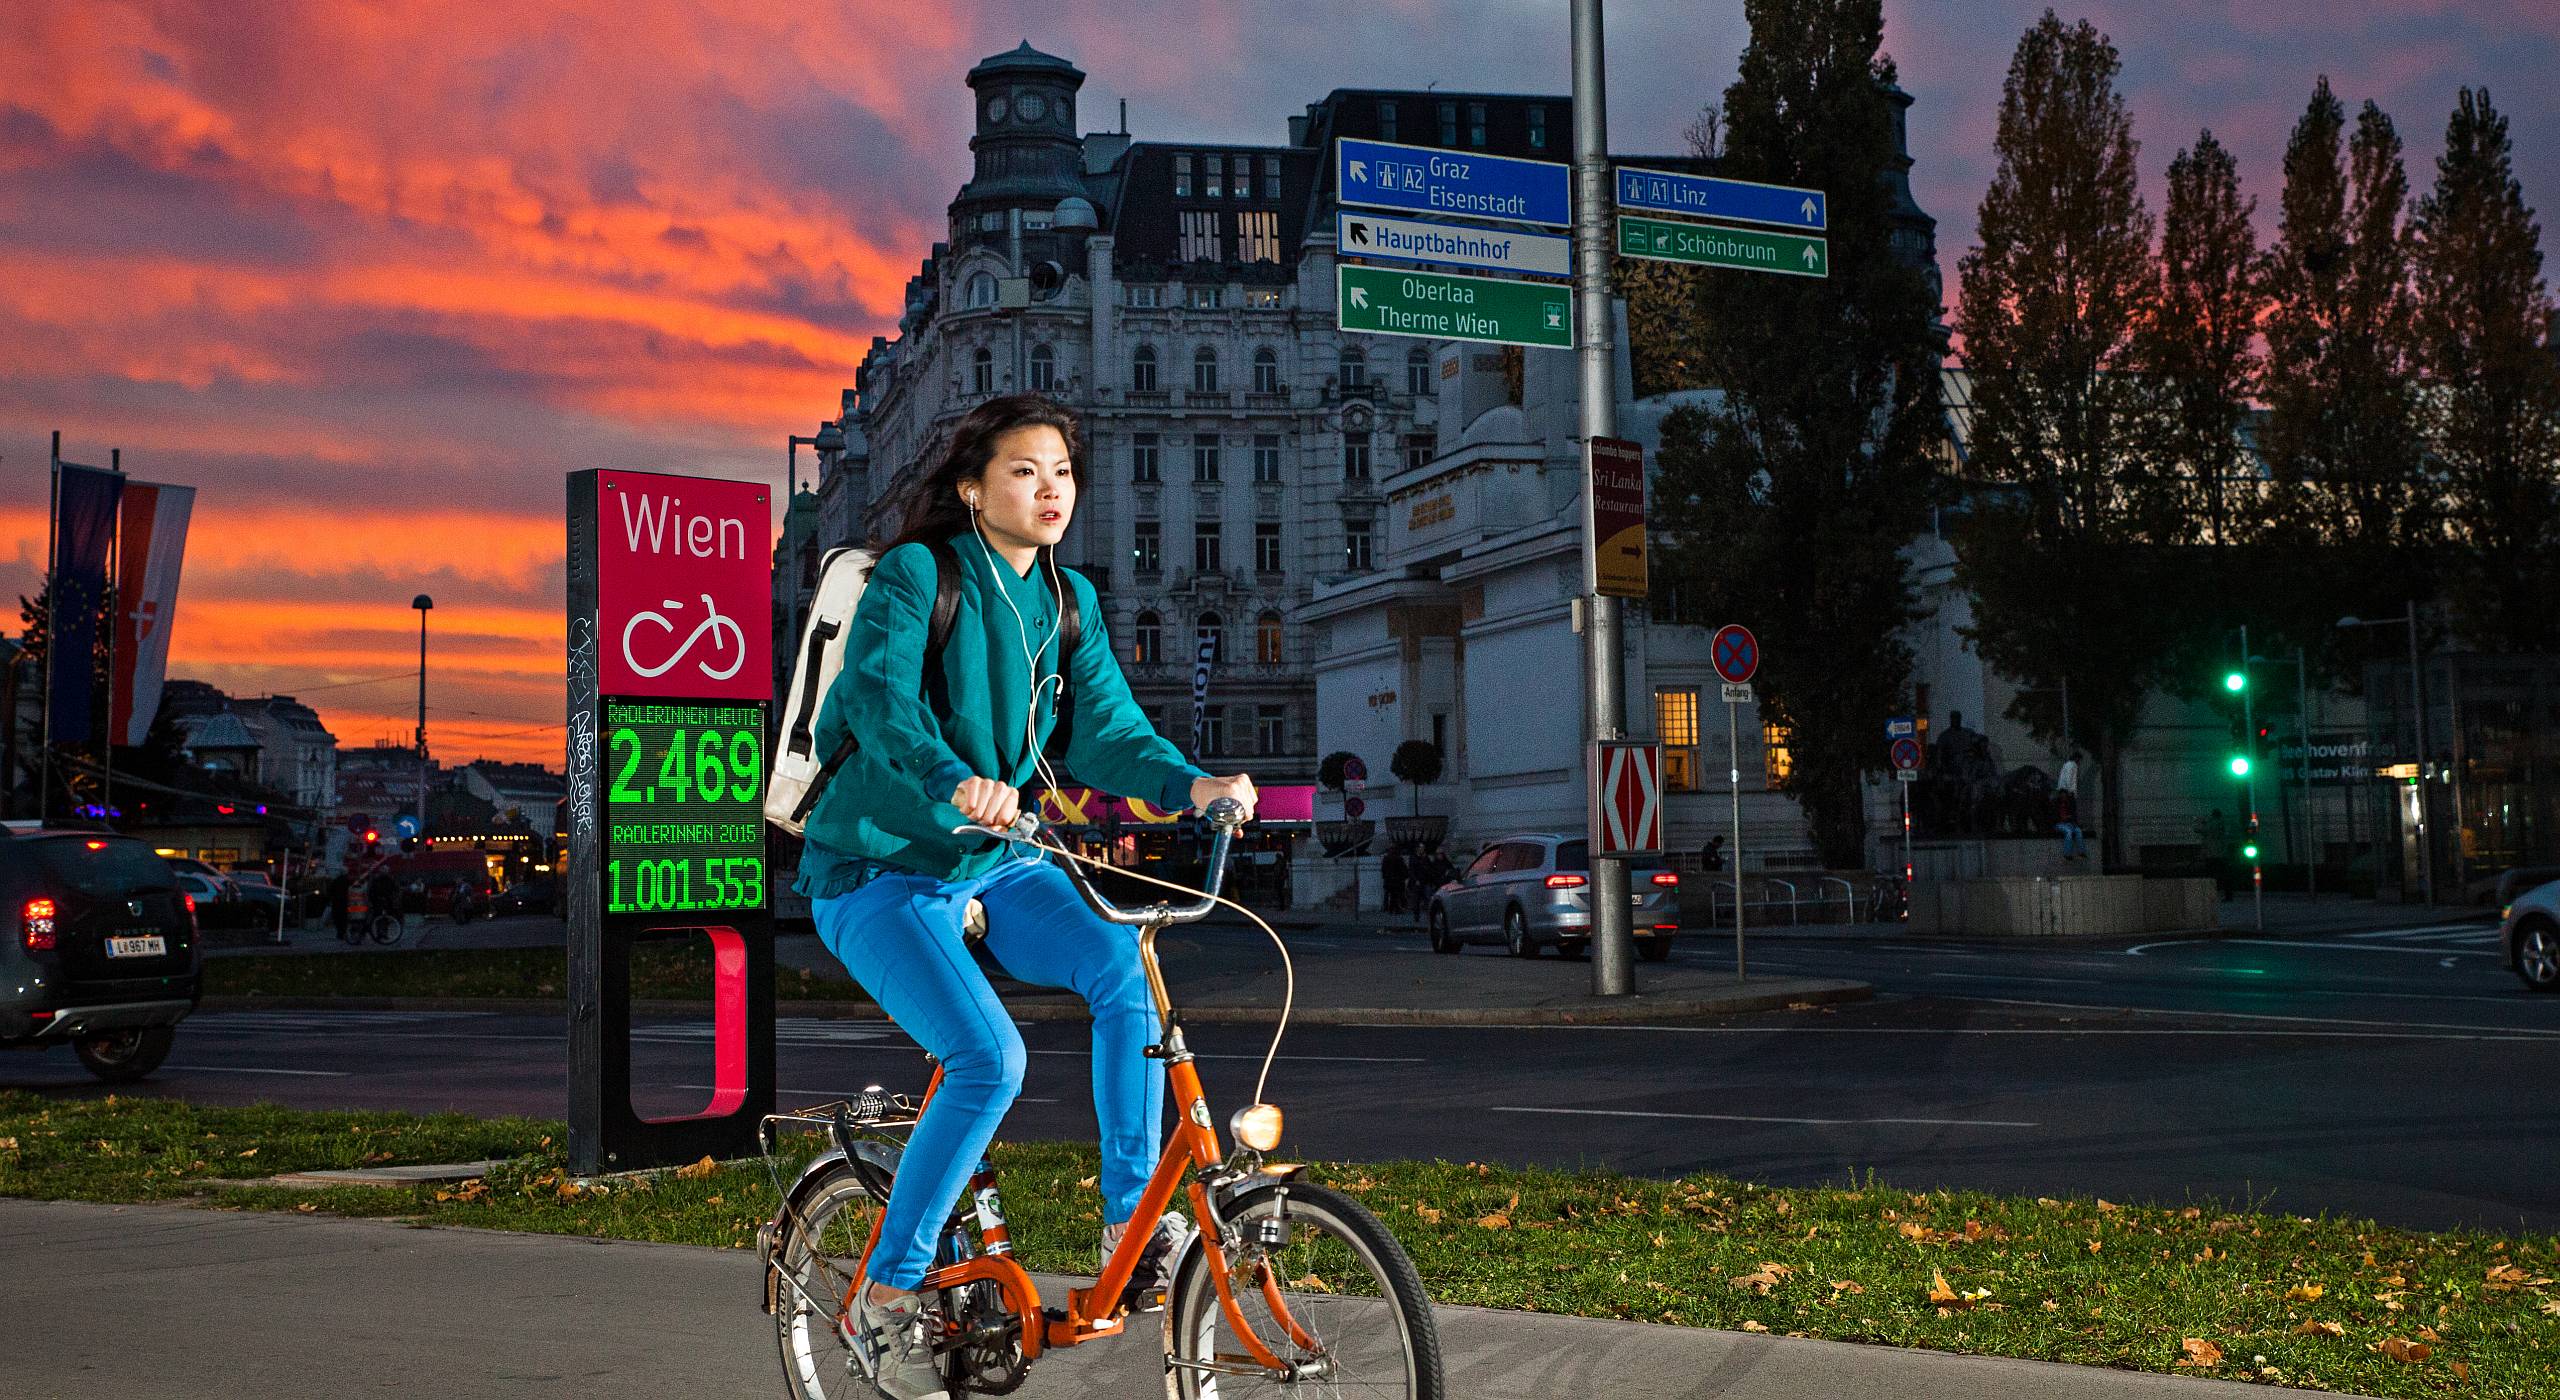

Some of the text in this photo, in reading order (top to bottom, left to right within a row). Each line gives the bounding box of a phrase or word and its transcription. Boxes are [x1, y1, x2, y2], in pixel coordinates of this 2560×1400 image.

[1404, 156, 1470, 190] A2 Graz
[1429, 186, 1526, 216] Eisenstadt
[1651, 181, 1707, 206] A1 Linz
[1376, 226, 1511, 260] Hauptbahnhof
[1677, 232, 1776, 261] Schönbrunn
[1402, 278, 1474, 304] Oberlaa
[1377, 305, 1499, 335] Therme Wien
[1594, 469, 1642, 491] Sri Lanka
[1595, 495, 1644, 515] Restaurant
[619, 491, 745, 560] Wien
[1725, 686, 1749, 700] Anfang
[608, 704, 759, 726] RADLERINNEN HEUTE
[608, 728, 760, 803] 2.469
[613, 824, 756, 844] RADLERINNEN 2015
[608, 857, 763, 912] 1.001.553
